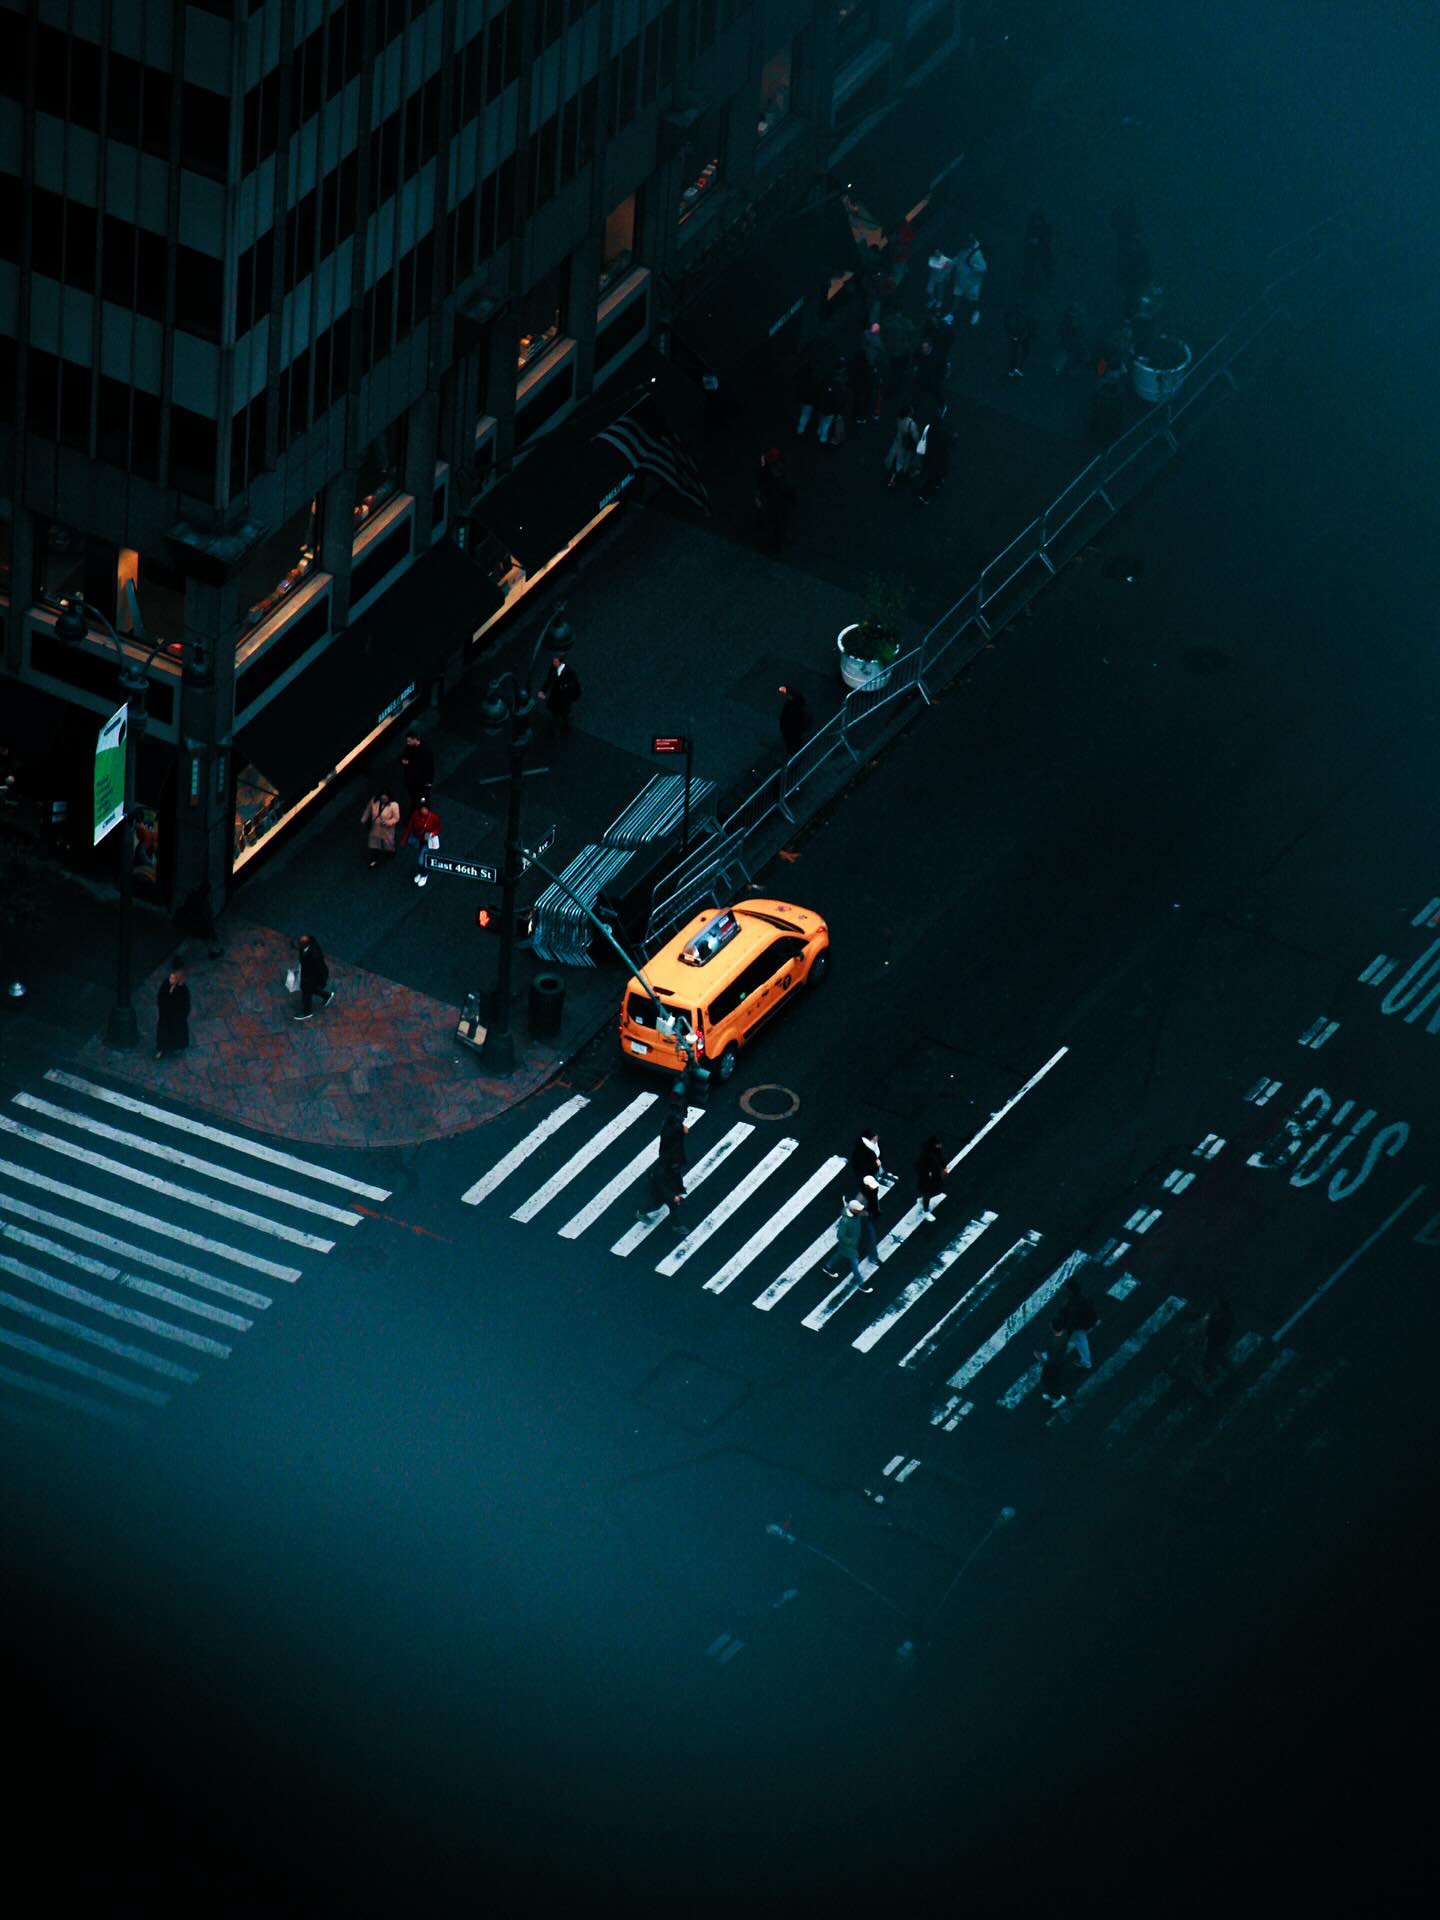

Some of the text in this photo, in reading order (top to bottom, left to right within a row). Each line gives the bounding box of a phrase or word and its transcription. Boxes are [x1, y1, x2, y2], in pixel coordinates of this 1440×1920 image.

[430, 858, 492, 879] East 46th St
[1245, 1086, 1412, 1203] BUS
